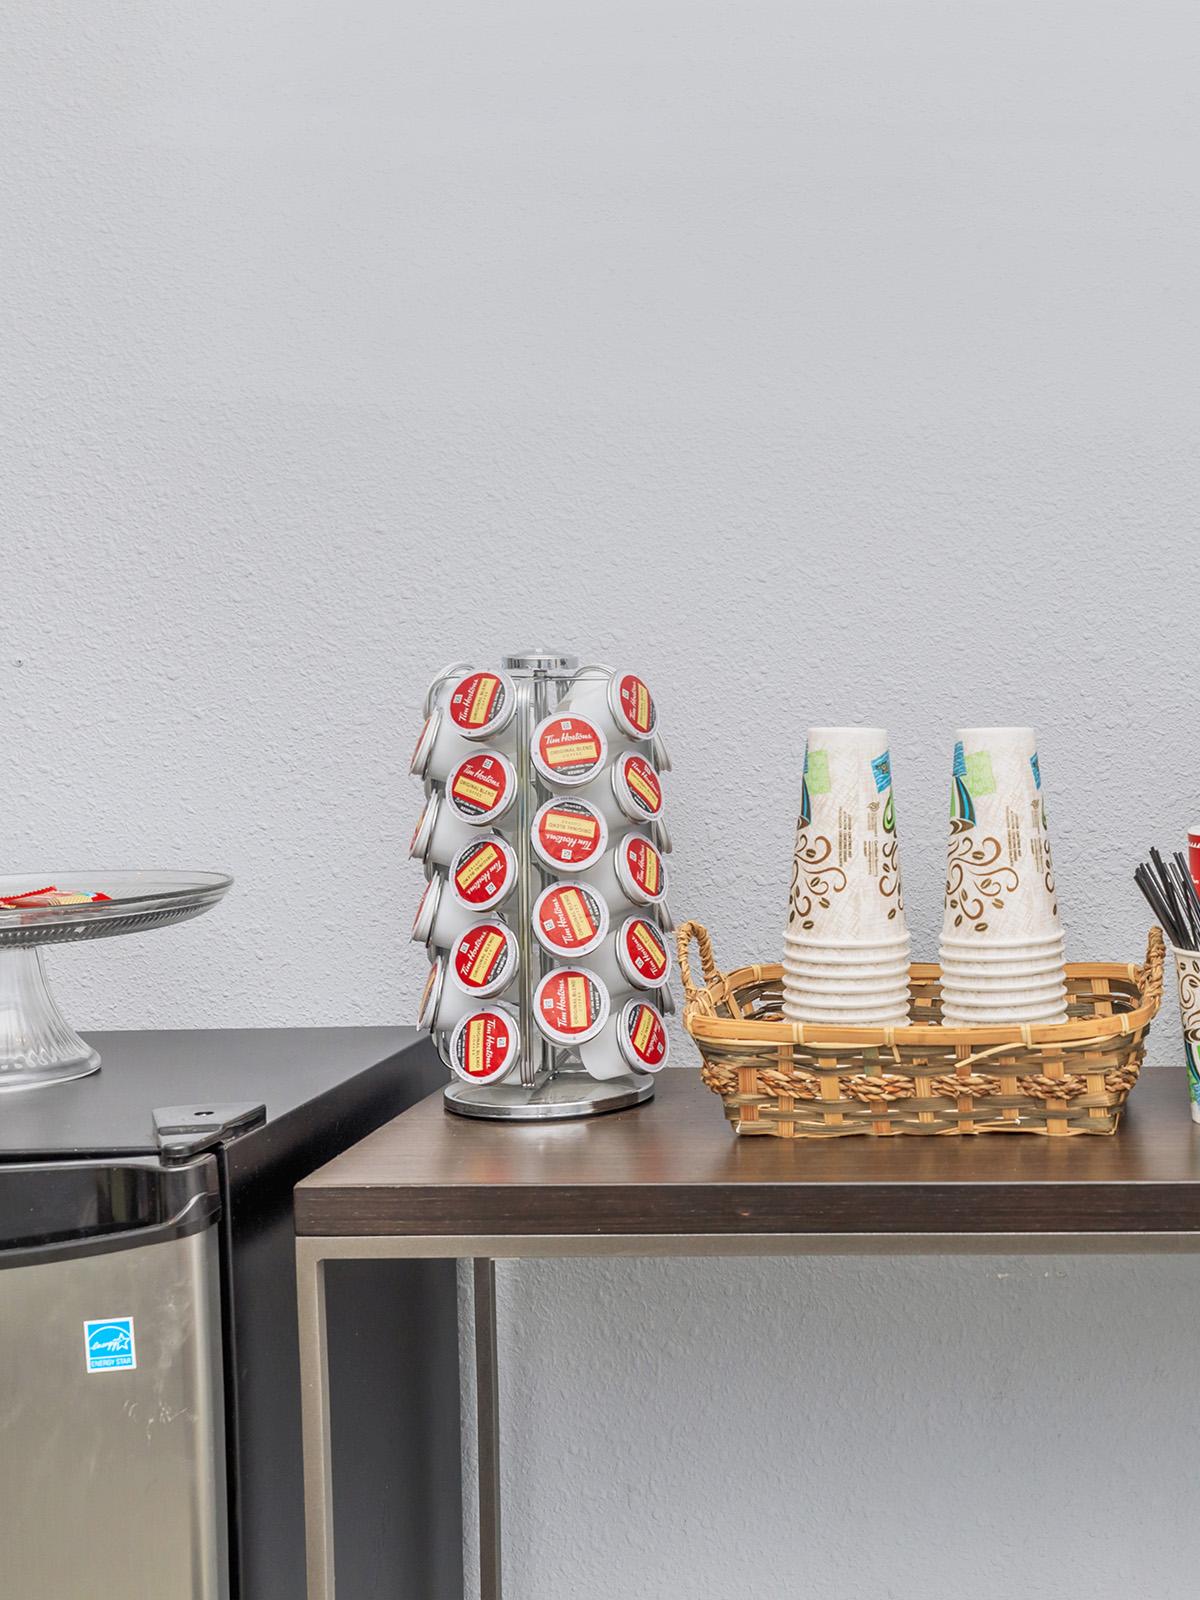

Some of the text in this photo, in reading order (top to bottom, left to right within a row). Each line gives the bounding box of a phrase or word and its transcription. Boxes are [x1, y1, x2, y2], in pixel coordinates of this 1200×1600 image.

[458, 679, 478, 720] Tim Hortons
[544, 732, 592, 744] Tim Hortons
[463, 764, 499, 787] Tim Hortons
[545, 833, 591, 850] Tim Hortons
[466, 860, 503, 894] Tim Hortons
[552, 897, 573, 944] Tim Hortons
[460, 931, 486, 975] Tim Hortons
[631, 935, 650, 961] Hortons
[649, 960, 657, 975] Tim
[556, 979, 567, 1027] Tim Hortons
[485, 1019, 495, 1068] Tim Hortons
